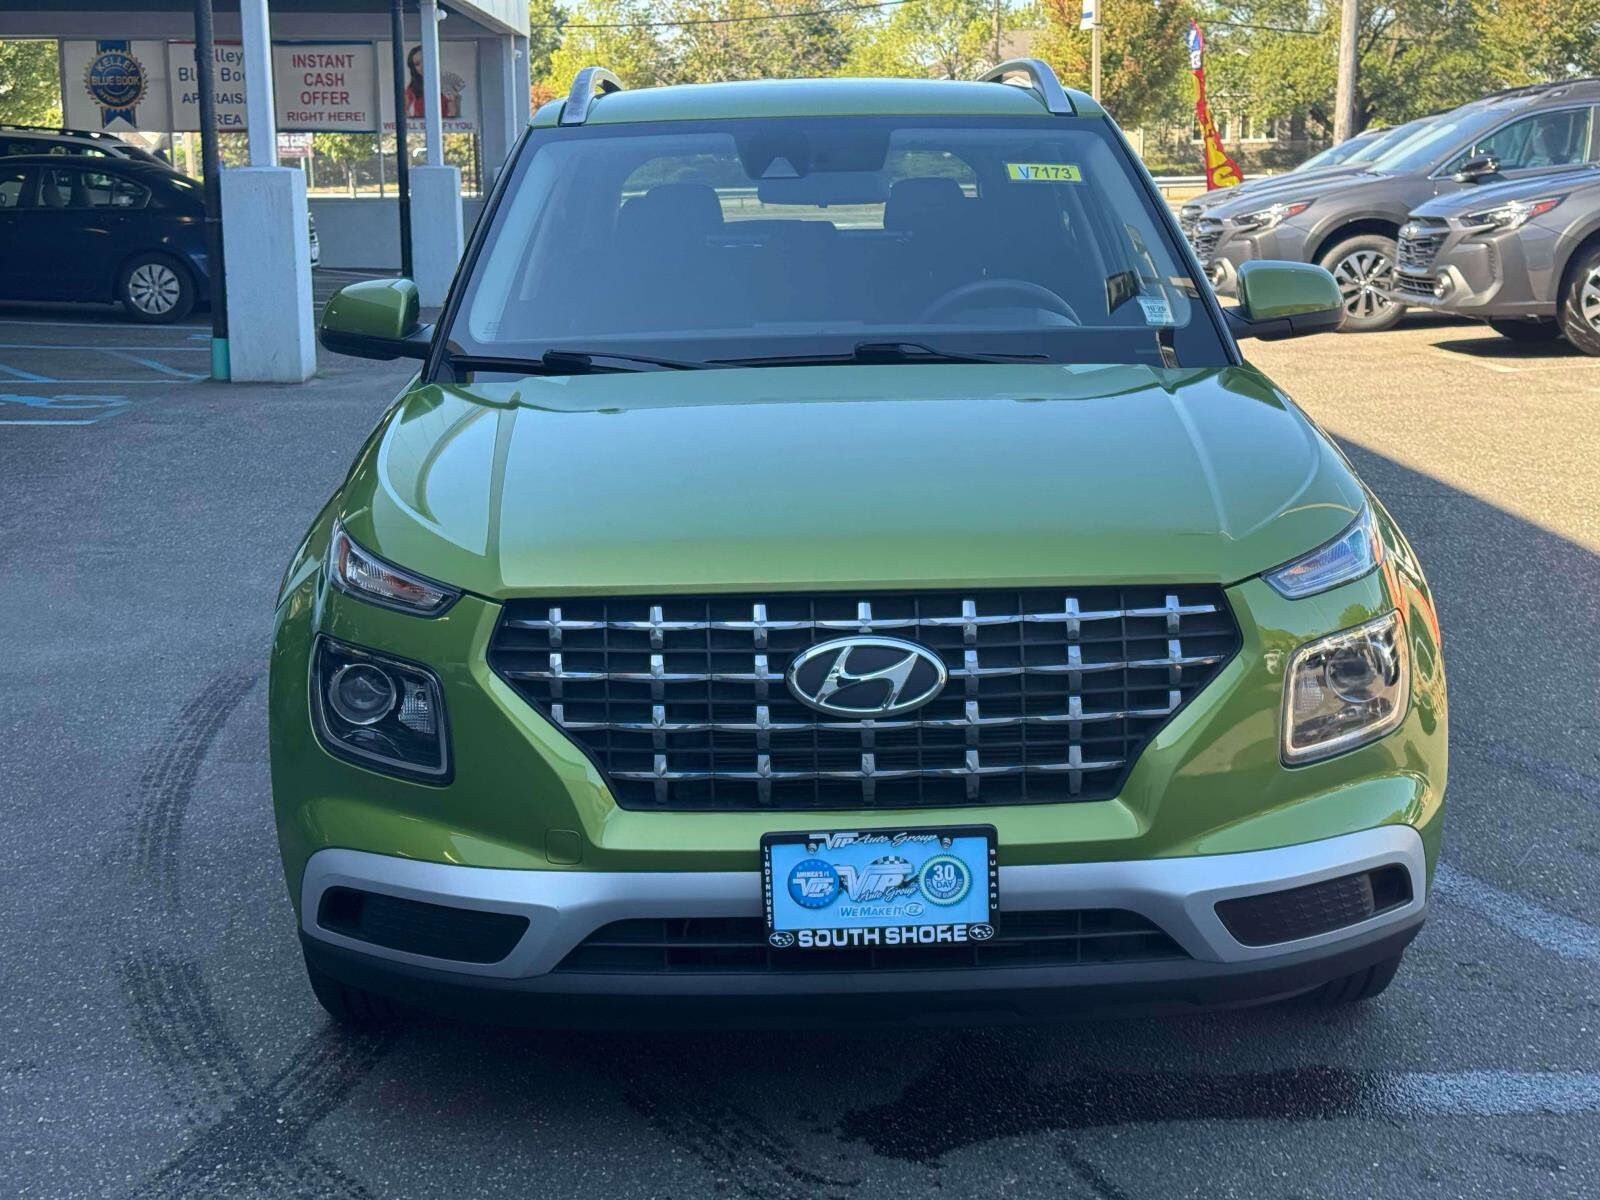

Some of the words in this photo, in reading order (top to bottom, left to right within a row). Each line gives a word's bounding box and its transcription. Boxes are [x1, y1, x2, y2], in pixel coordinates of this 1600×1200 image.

[95, 56, 137, 72] KELLEY
[292, 54, 354, 68] INSTANT
[91, 75, 114, 85] BLUE
[115, 75, 140, 85] BOOK
[304, 73, 345, 87] CASH
[300, 91, 350, 105] OFFER
[214, 113, 242, 125] REA
[287, 111, 325, 122] RIGHT
[328, 111, 366, 122] HERE!
[1017, 166, 1072, 179] V7173
[809, 832, 859, 849] VIP
[856, 833, 889, 845] Auto
[890, 832, 937, 848] Group
[933, 864, 955, 881] 30
[989, 848, 997, 910] SUBARU
[764, 845, 773, 928] LINDENHURST
[833, 863, 913, 900] VIP
[936, 881, 953, 889] DAY
[858, 889, 884, 902] Auto
[884, 886, 919, 902] Group
[798, 928, 880, 947] SOUTH
[885, 924, 968, 945] SHORE
